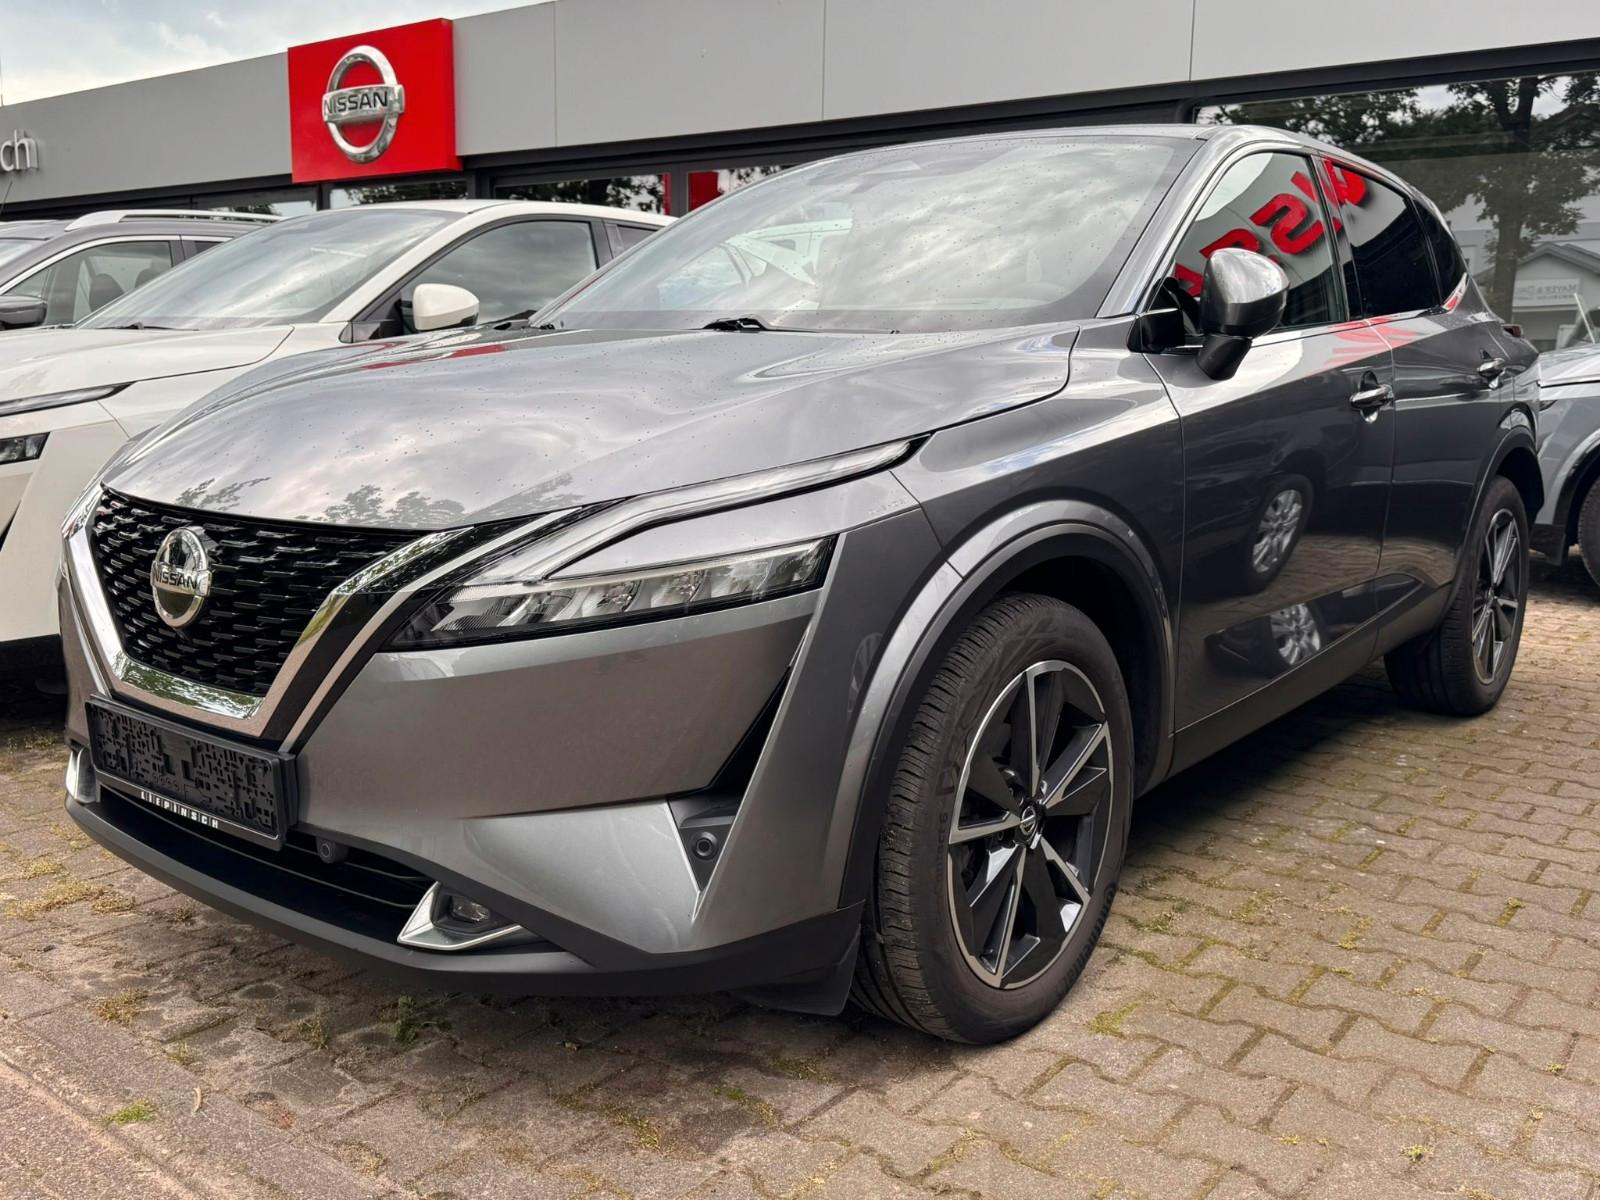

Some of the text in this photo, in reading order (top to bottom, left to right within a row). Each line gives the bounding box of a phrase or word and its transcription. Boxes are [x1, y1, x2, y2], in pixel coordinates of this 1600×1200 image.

[323, 90, 388, 115] NISSAN
[0, 129, 36, 171] ch
[151, 563, 198, 590] NISSAN
[140, 791, 219, 829] LIEPINSCH
